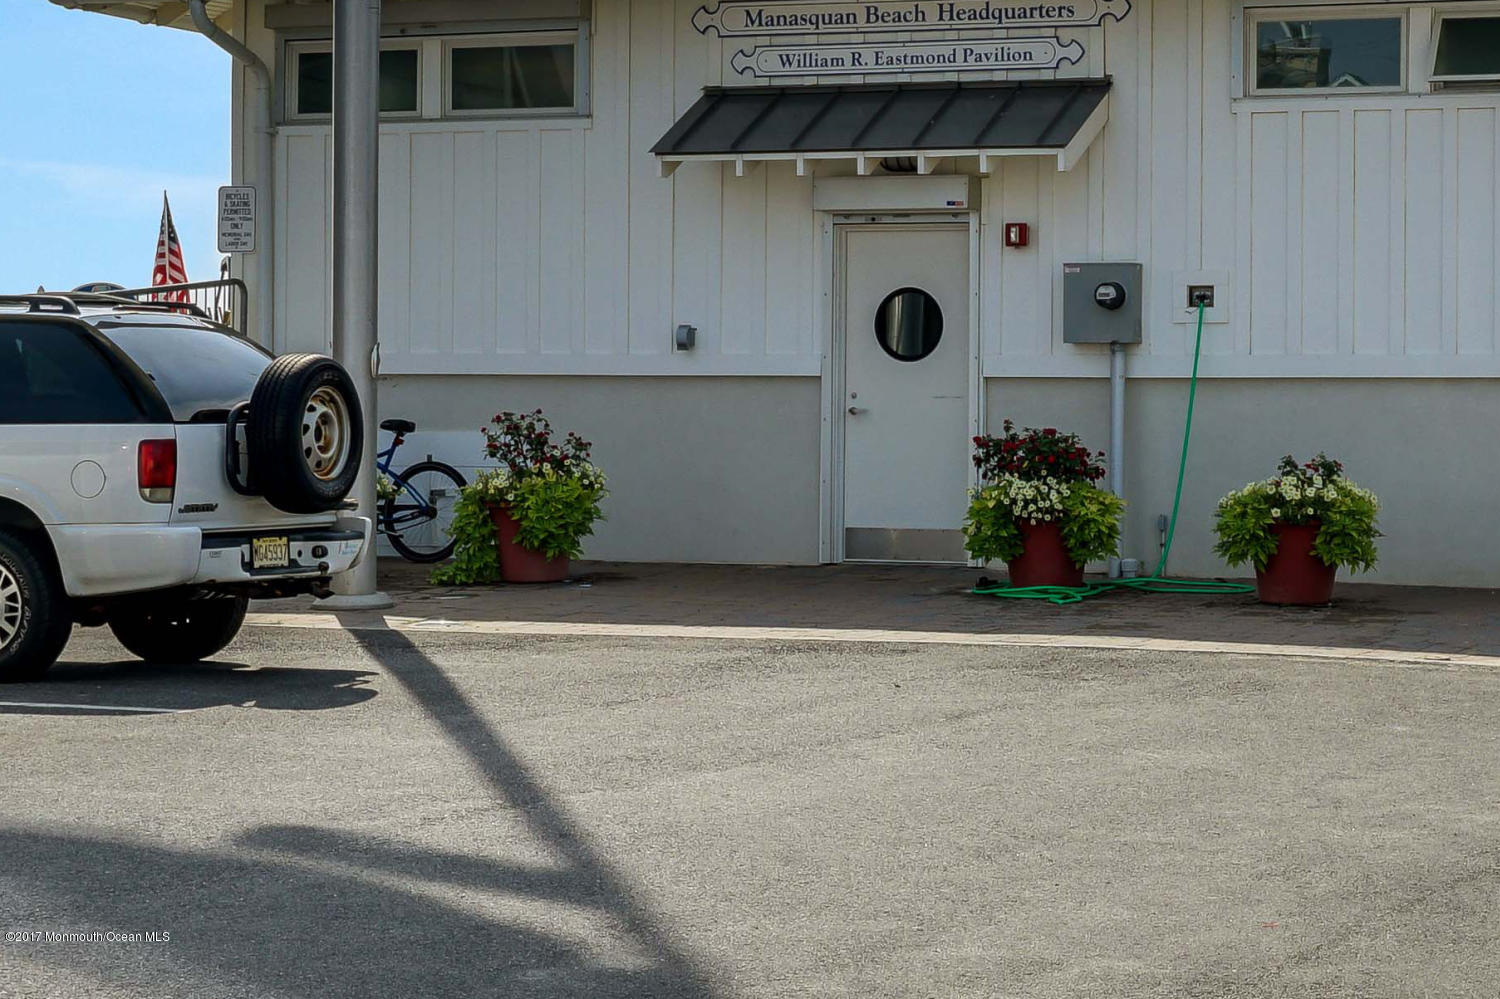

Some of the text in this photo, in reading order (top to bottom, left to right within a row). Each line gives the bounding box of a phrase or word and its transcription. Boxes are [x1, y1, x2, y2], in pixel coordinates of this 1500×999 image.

[743, 0, 1075, 31] Manasquan Beach Headquarters
[777, 46, 1034, 69] William R. Eastmond Pavilion
